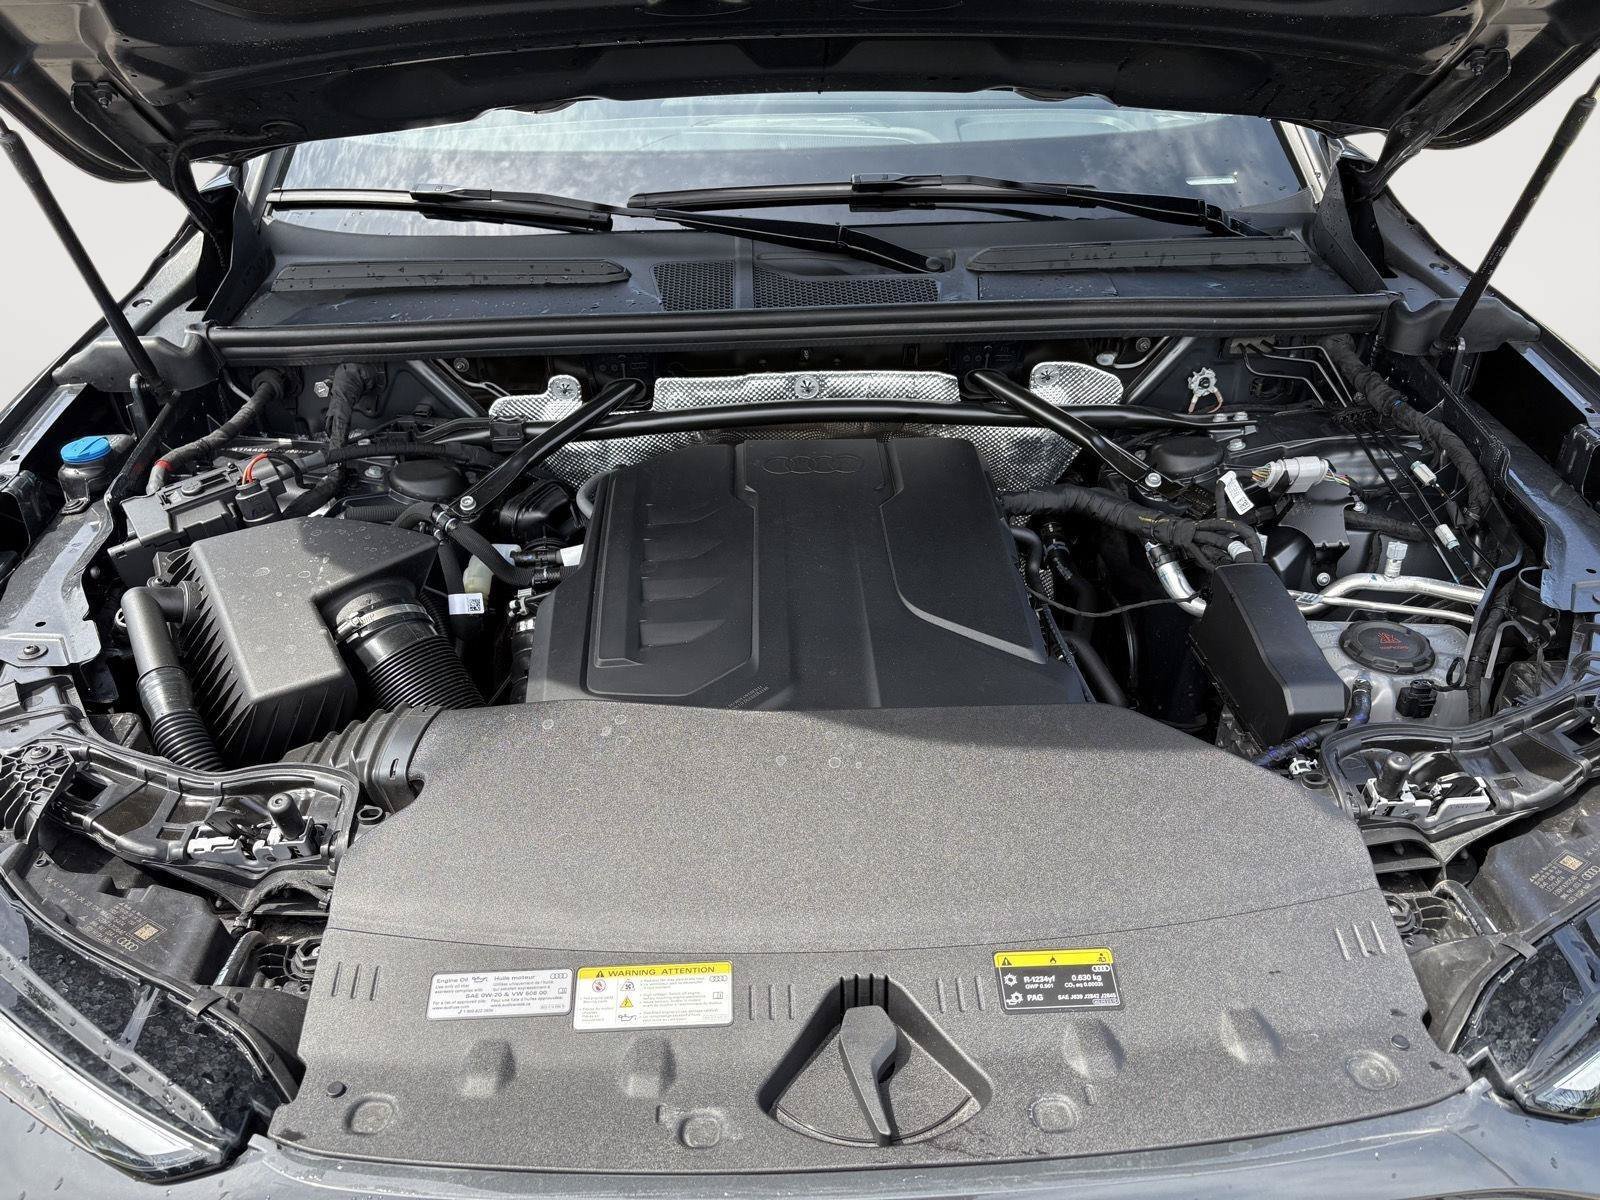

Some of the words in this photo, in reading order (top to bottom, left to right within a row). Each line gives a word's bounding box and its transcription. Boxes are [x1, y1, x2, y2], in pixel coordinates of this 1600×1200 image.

[608, 968, 656, 977] WARNING
[661, 966, 715, 975] ATTENTION
[1092, 973, 1102, 981] kg
